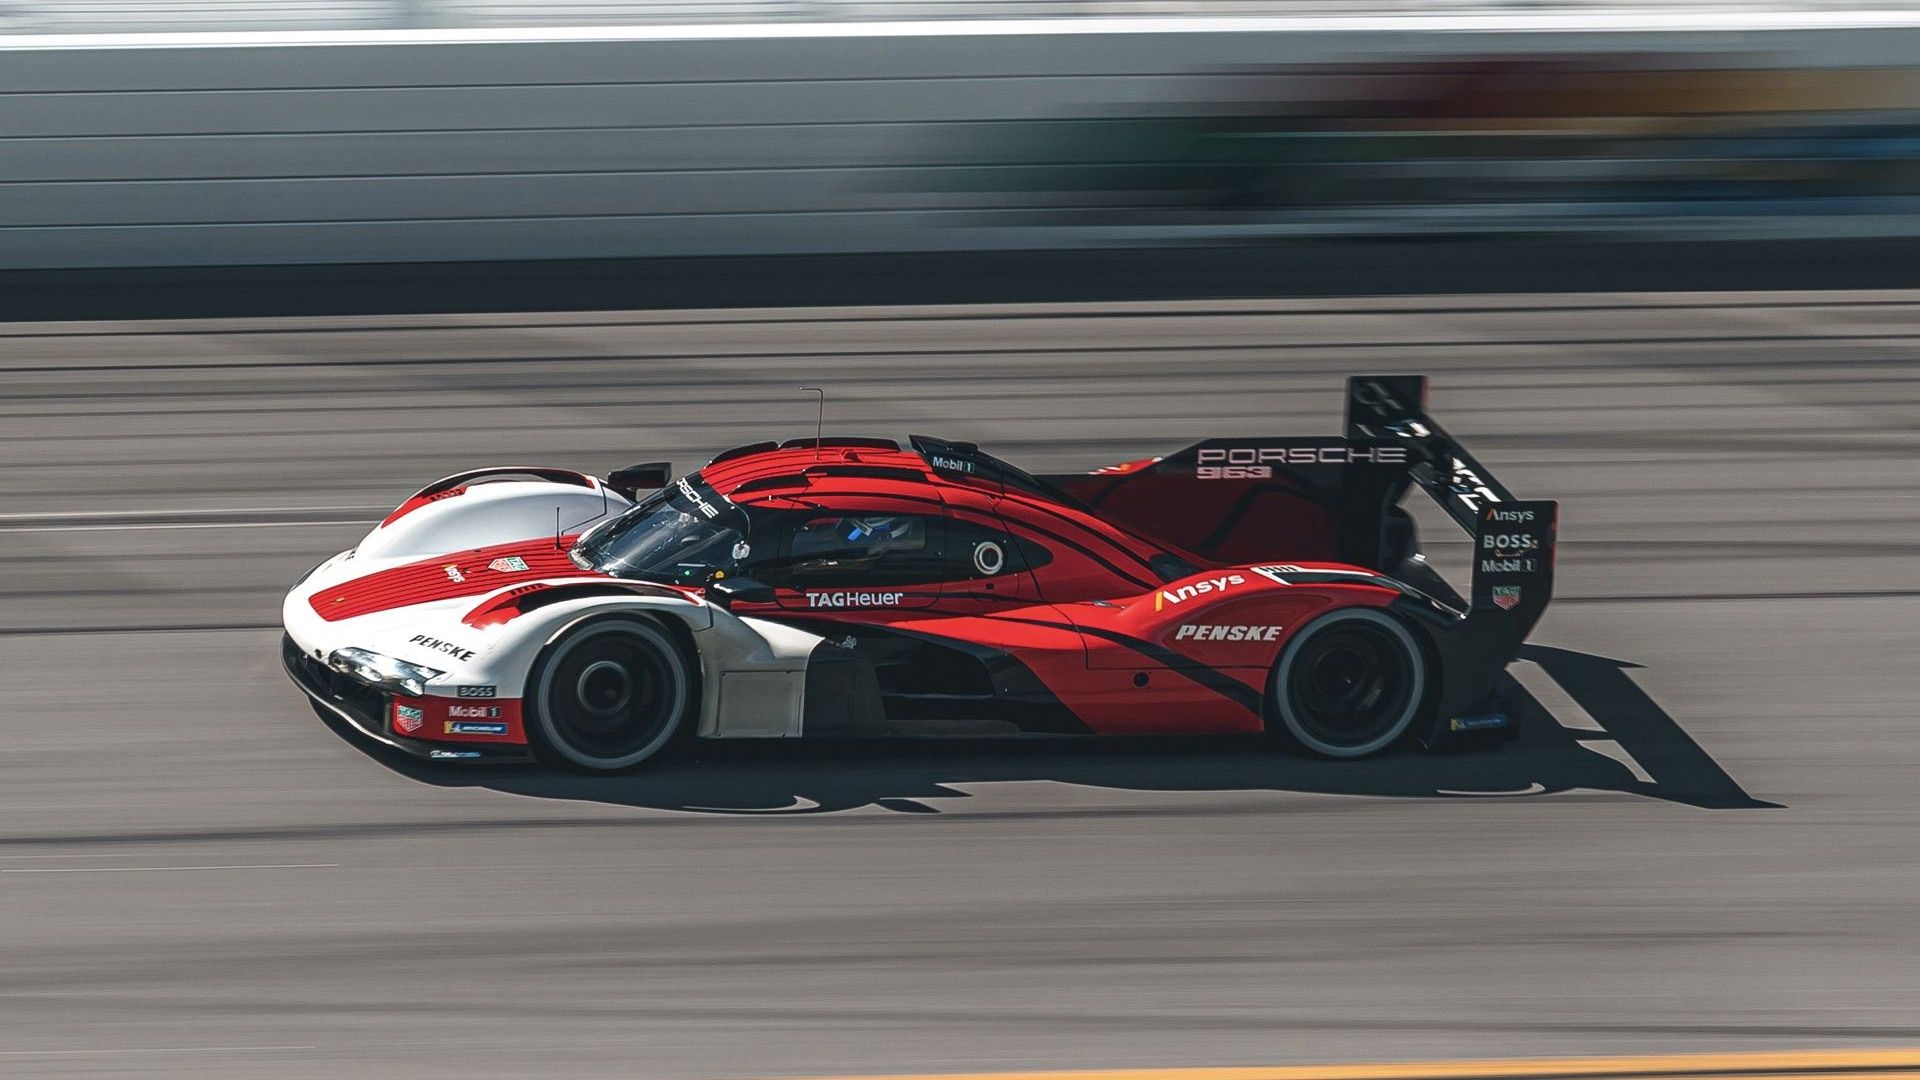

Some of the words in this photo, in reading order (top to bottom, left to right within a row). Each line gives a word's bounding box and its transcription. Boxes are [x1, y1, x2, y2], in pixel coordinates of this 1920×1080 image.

[932, 456, 963, 471] Mobil
[1198, 447, 1407, 465] PORSCHE
[1197, 466, 1272, 479] 963
[1486, 508, 1535, 523] Ansys
[1483, 534, 1532, 548] BOSS
[1481, 560, 1521, 572] Mobil
[1155, 574, 1245, 613] Ansys
[1175, 624, 1282, 641] PENSKE
[409, 634, 476, 662] PENSKE
[460, 687, 493, 696] BOSS
[448, 706, 487, 717] Mobil
